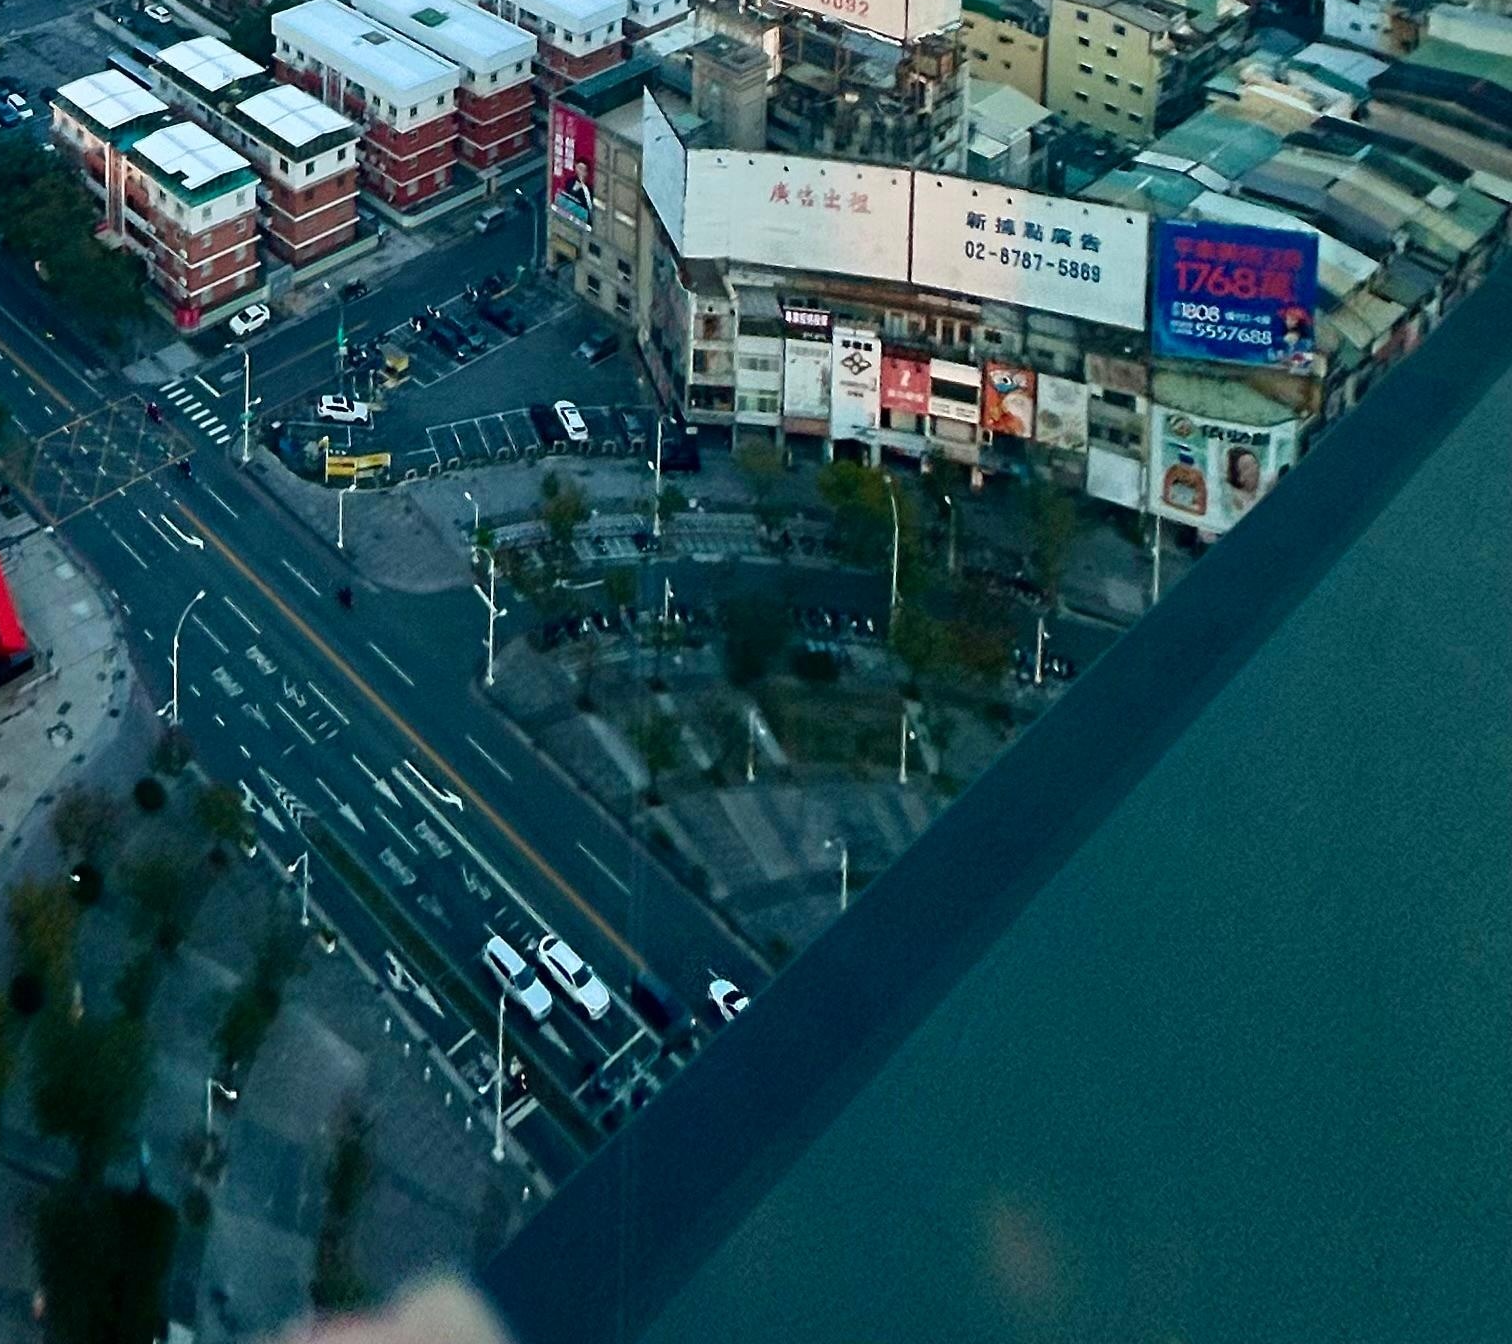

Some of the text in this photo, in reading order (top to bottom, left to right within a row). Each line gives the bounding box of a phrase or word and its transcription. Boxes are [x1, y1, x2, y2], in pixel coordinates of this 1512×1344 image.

[966, 210, 1102, 254] 新據點廣告
